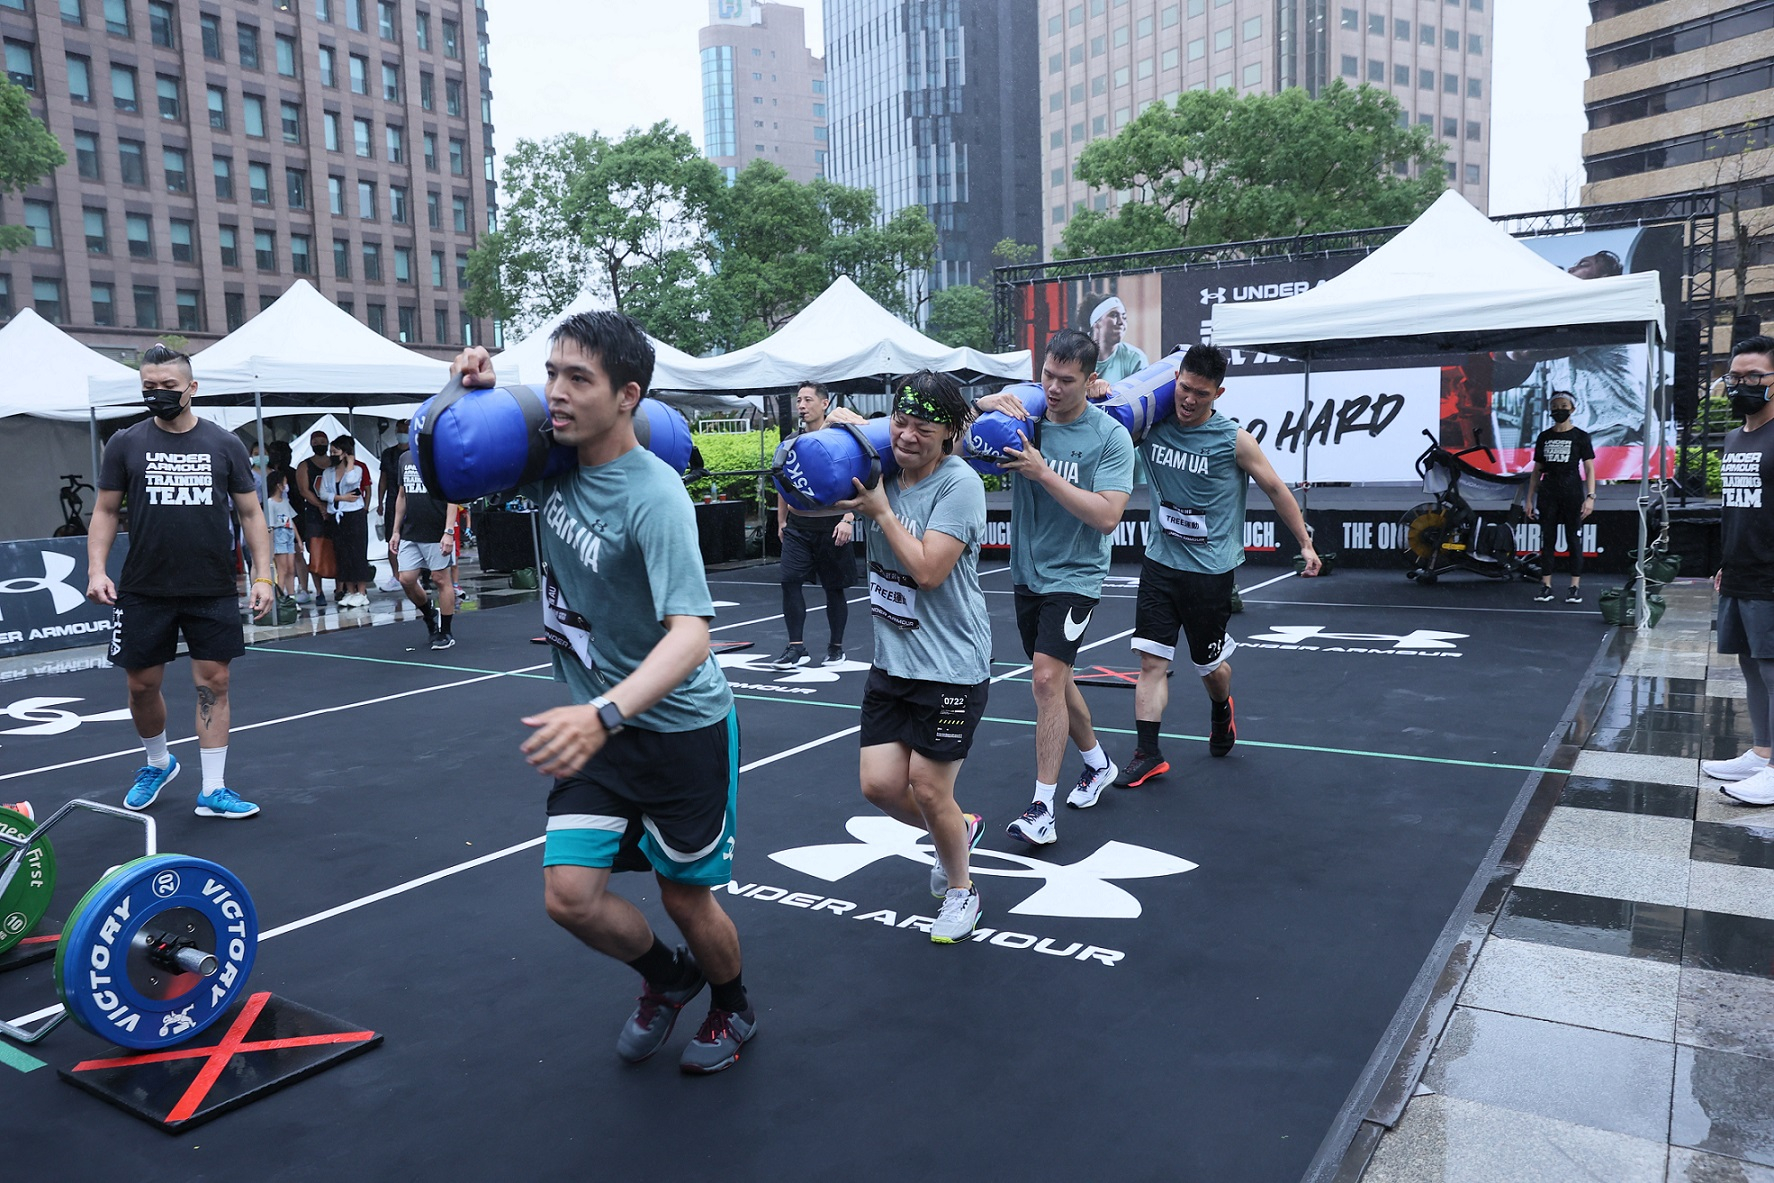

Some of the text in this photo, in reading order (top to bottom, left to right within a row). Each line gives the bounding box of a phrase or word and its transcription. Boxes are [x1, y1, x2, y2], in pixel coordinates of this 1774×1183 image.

[1233, 281, 1309, 301] UNDER
[1275, 393, 1405, 454] HARD
[145, 452, 211, 463] UNDER
[146, 462, 211, 472] ARMOUR
[1151, 443, 1209, 475] TEAM UA
[1722, 452, 1762, 463] UNDER
[1721, 463, 1760, 472] ARMOUR
[145, 475, 212, 486] TRAINING
[145, 486, 213, 505] TEAM
[1343, 522, 1373, 549] THE
[944, 697, 964, 705] 0722
[26, 847, 44, 888] First
[157, 872, 175, 895] 20
[6, 915, 24, 931] 10
[202, 878, 246, 1008] VICTORY
[90, 895, 142, 1033] VICTORY
